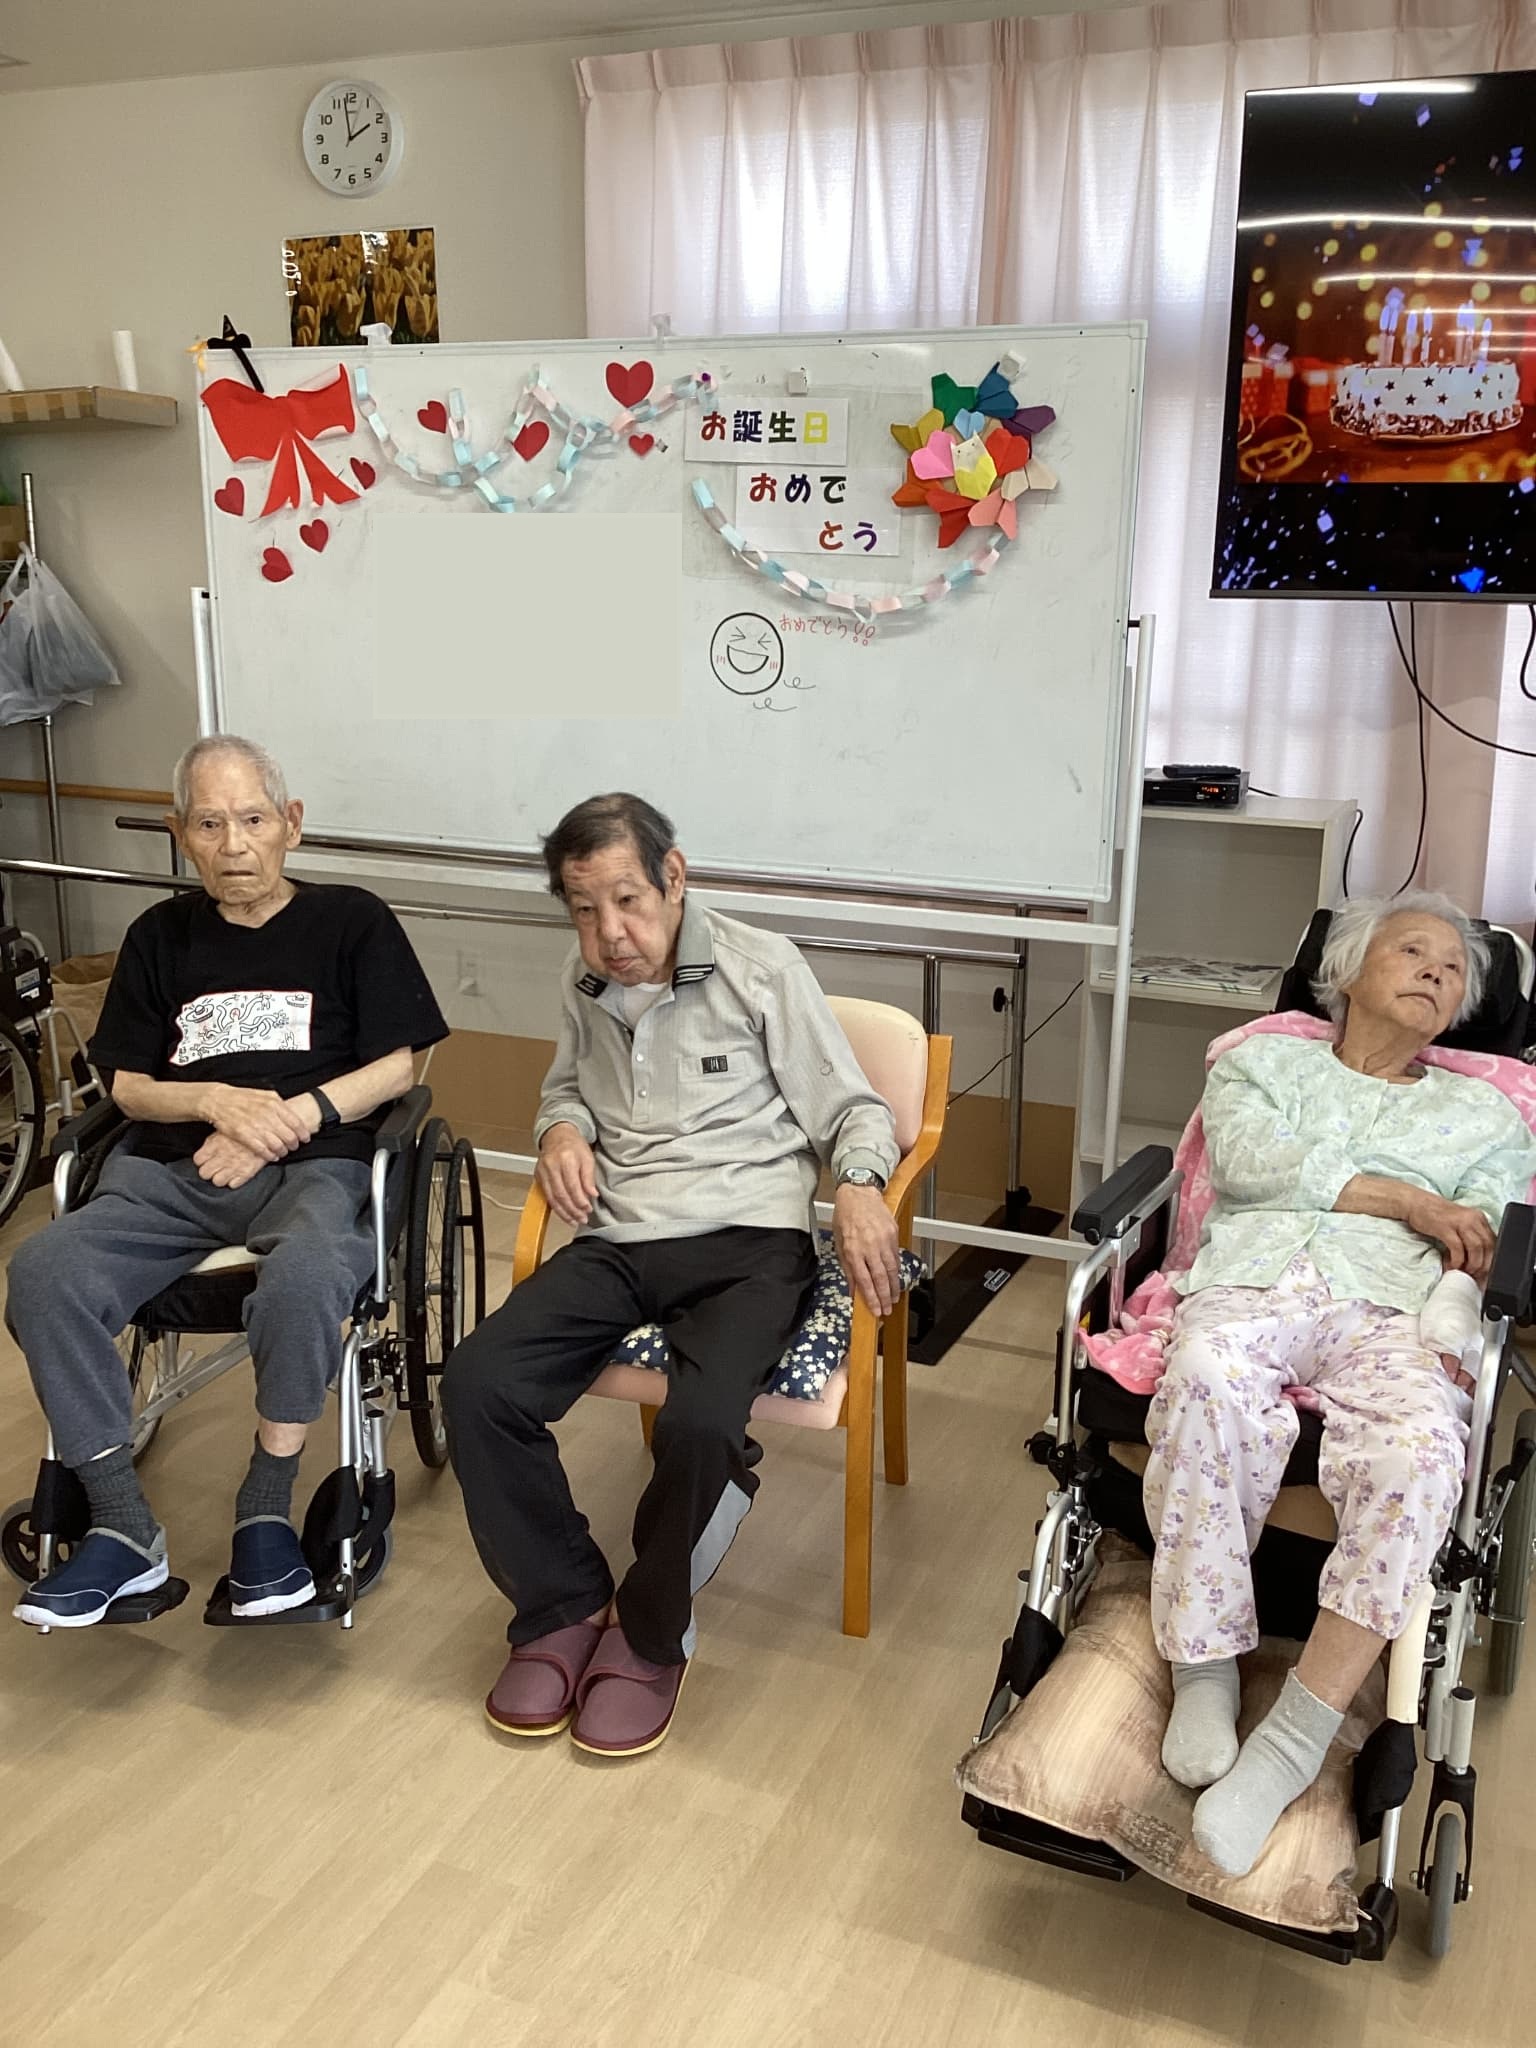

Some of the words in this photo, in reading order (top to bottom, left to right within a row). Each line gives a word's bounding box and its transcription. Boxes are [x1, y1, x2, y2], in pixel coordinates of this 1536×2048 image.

[345, 92, 357, 103] 12
[332, 98, 341, 110] 11
[320, 114, 333, 125] 10
[375, 113, 384, 124] 2
[316, 134, 324, 145] 9
[381, 132, 388, 143] 3
[321, 154, 329, 164] 8
[375, 153, 383, 163] 4
[334, 168, 342, 179] 7
[363, 168, 372, 178] 5
[348, 174, 356, 184] 6
[701, 410, 829, 444] お誕生日
[749, 473, 847, 504] おめで
[819, 521, 877, 552] とう
